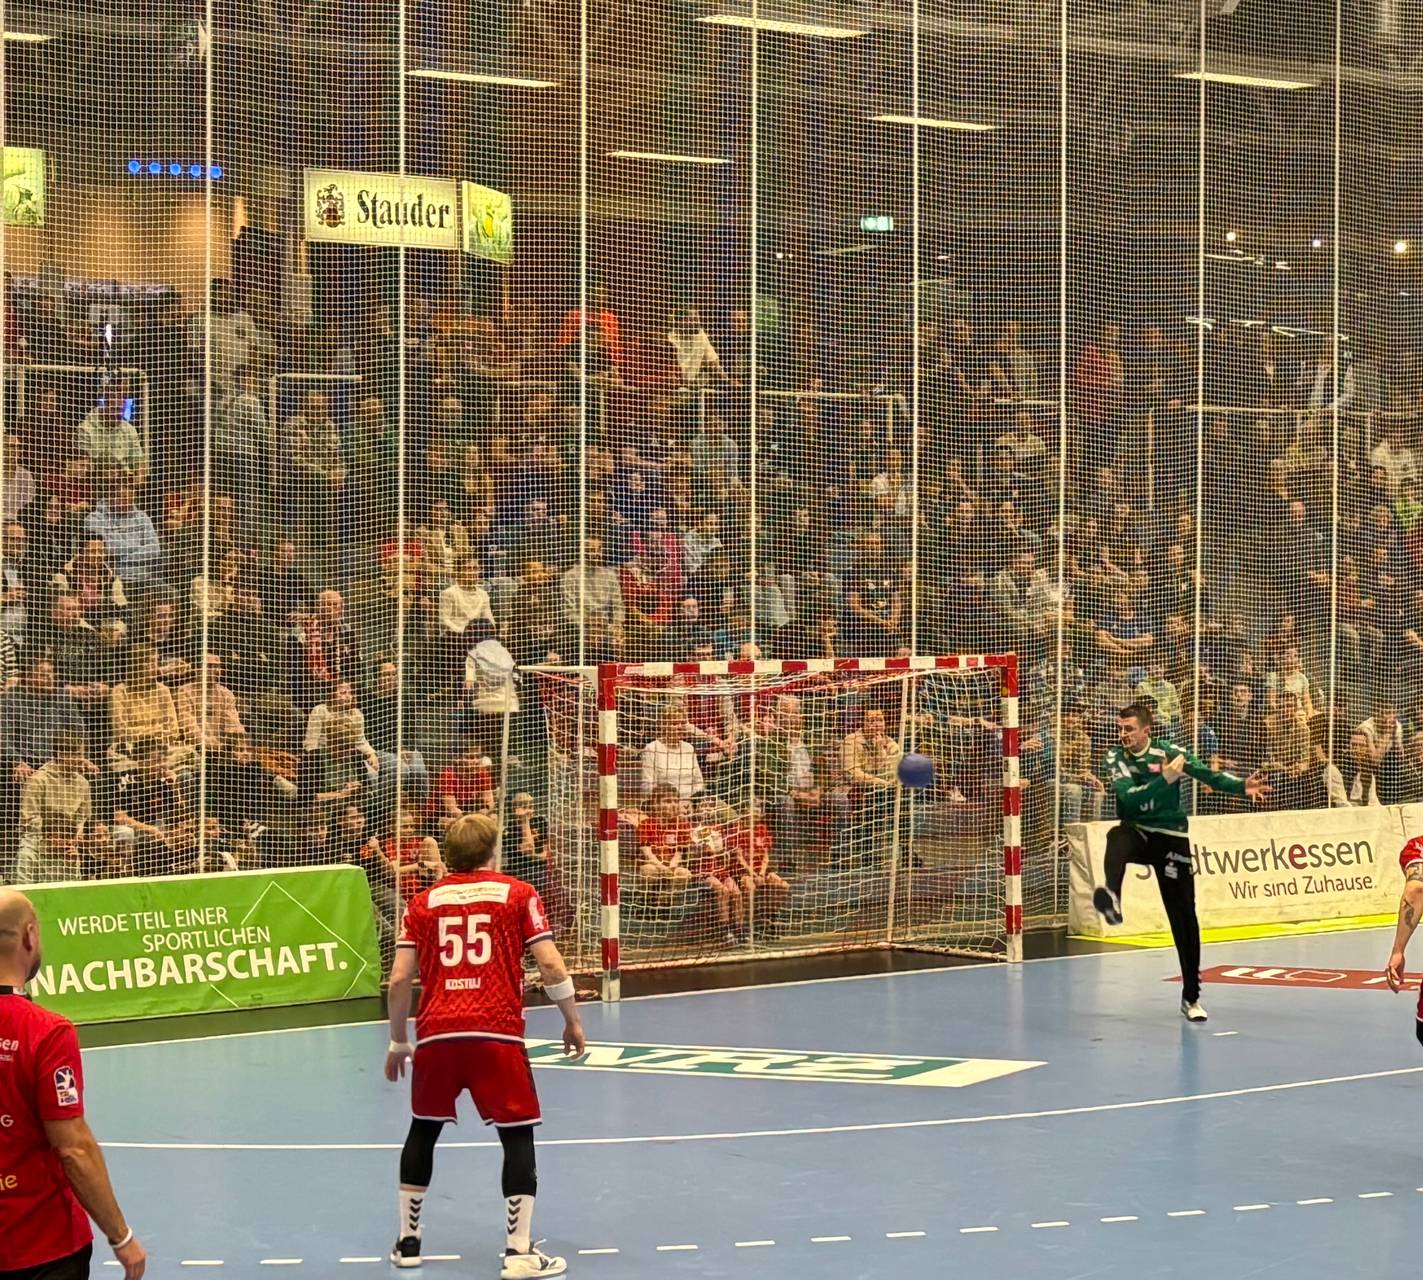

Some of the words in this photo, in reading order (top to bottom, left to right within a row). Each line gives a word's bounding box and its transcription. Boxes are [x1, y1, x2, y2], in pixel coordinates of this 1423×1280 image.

[357, 190, 451, 229] Stauder
[1228, 880, 1259, 900] Wir
[1263, 877, 1299, 897] sind
[1302, 873, 1378, 895] Zuhause.
[57, 913, 129, 937] WERDE
[131, 911, 171, 930] TEIL
[175, 906, 229, 928] EINER
[142, 926, 271, 953] SPORTLICHEN
[437, 913, 493, 967] 55
[31, 941, 349, 998] NACHBARSCHAFT.
